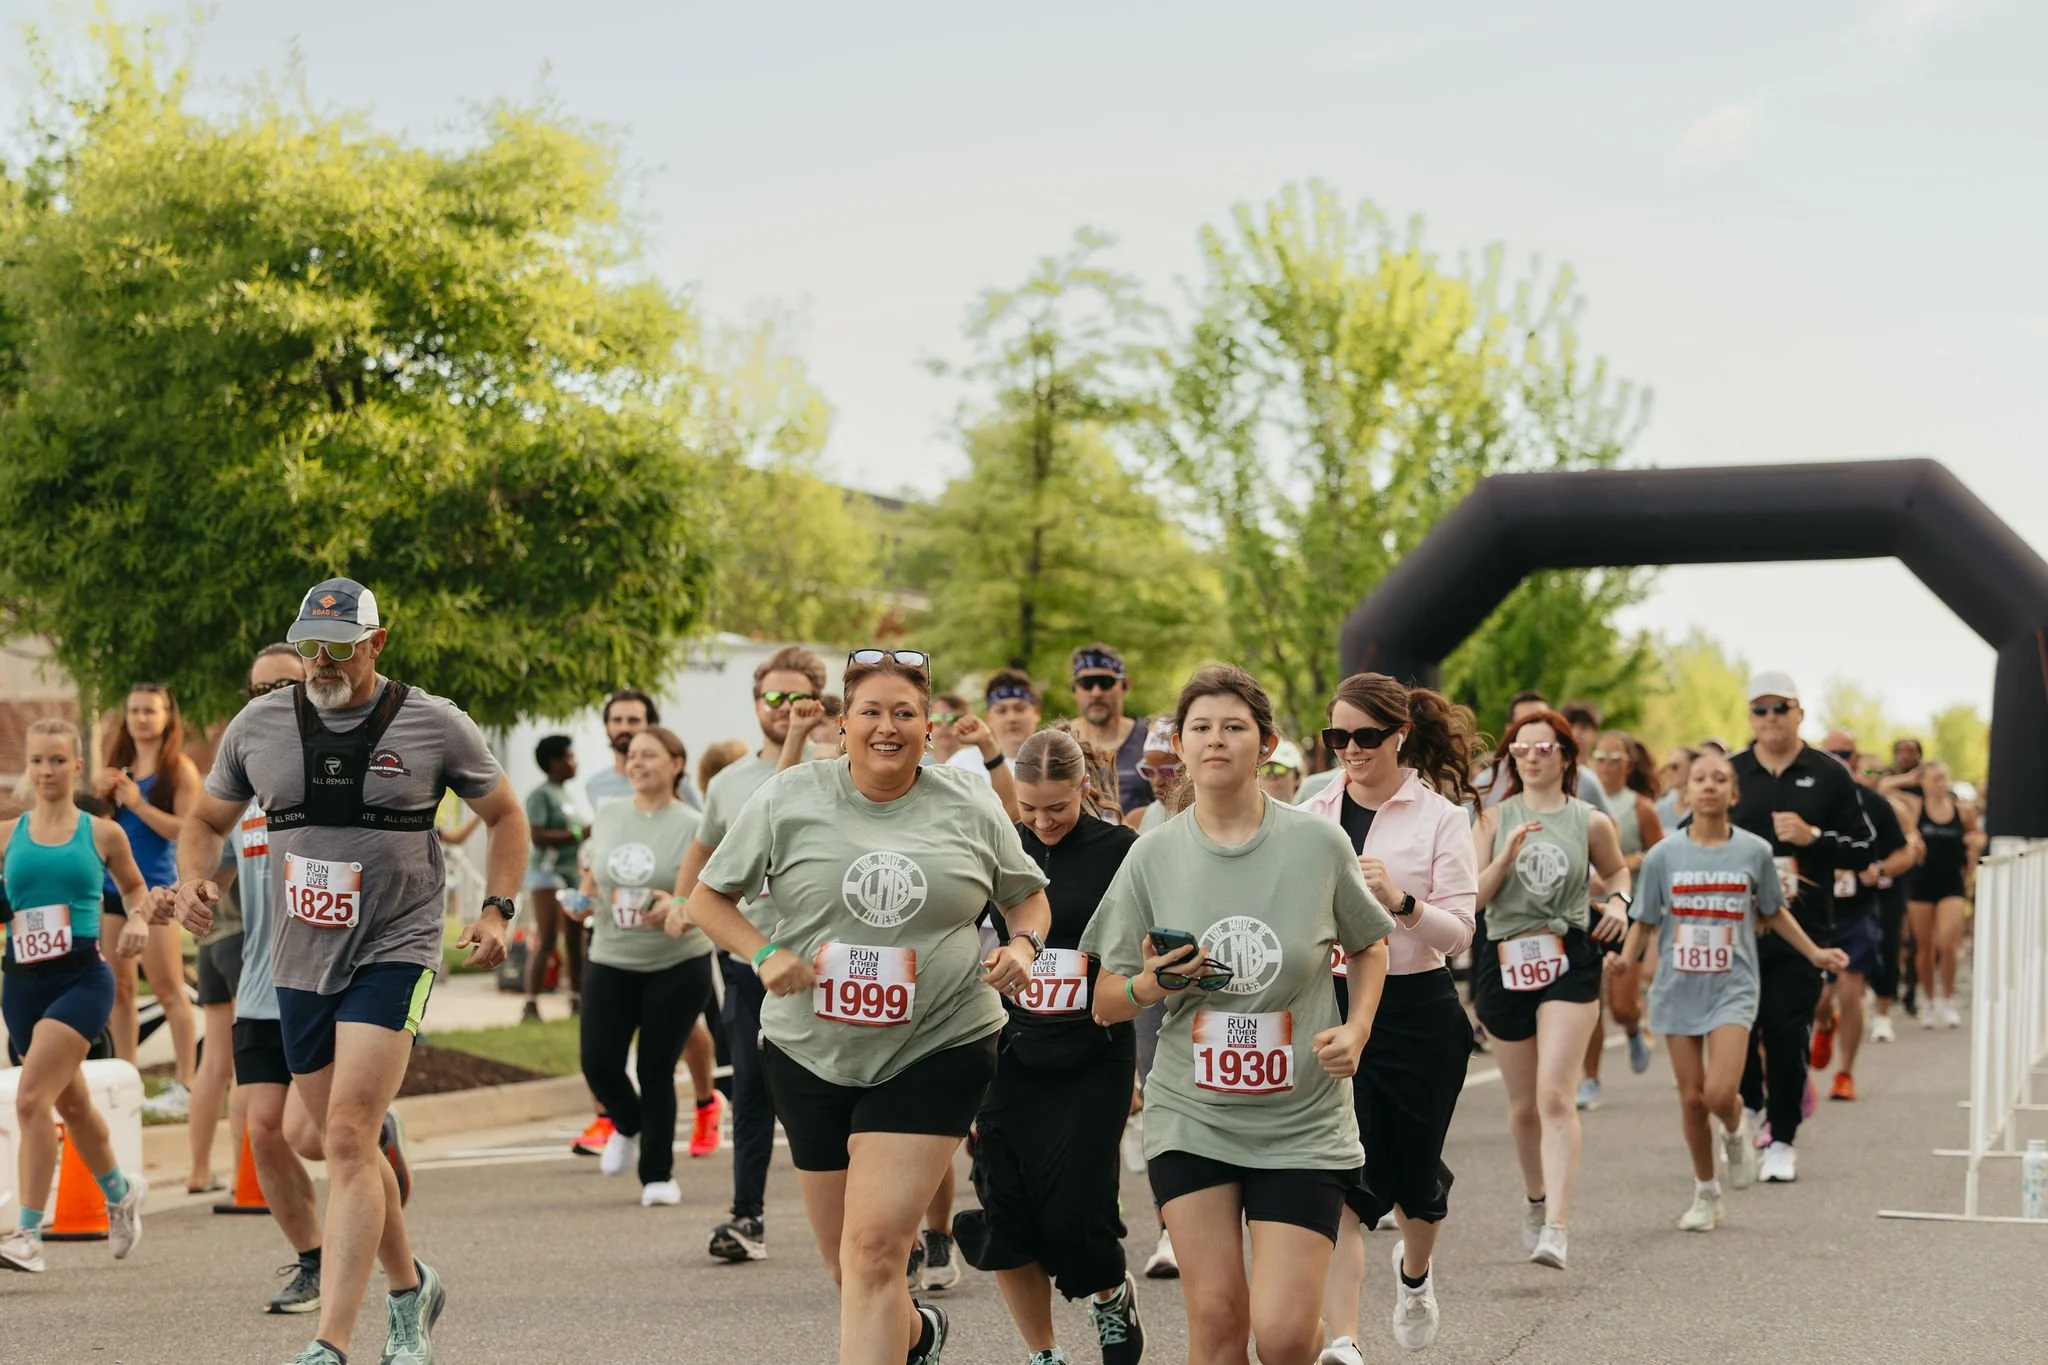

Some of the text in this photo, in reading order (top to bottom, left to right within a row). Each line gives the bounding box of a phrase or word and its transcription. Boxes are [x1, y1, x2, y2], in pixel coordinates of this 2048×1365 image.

[312, 777, 323, 785] ALL
[384, 815, 398, 823] ALL
[307, 863, 329, 873] RUN
[306, 876, 328, 886] LIVES
[864, 868, 908, 910] LMB
[289, 885, 353, 922] 1825
[862, 911, 902, 925] FITNESS
[16, 929, 68, 959] 1834
[849, 950, 879, 961] RUN
[1218, 934, 1262, 978] LMB
[1679, 947, 1728, 968] 1819
[849, 966, 878, 976] LIVES
[1506, 958, 1562, 986] 1967
[820, 978, 908, 1020] 1999
[1228, 1018, 1257, 1029] RUN
[1227, 1035, 1257, 1044] LIVES
[1199, 1047, 1287, 1087] 1930
